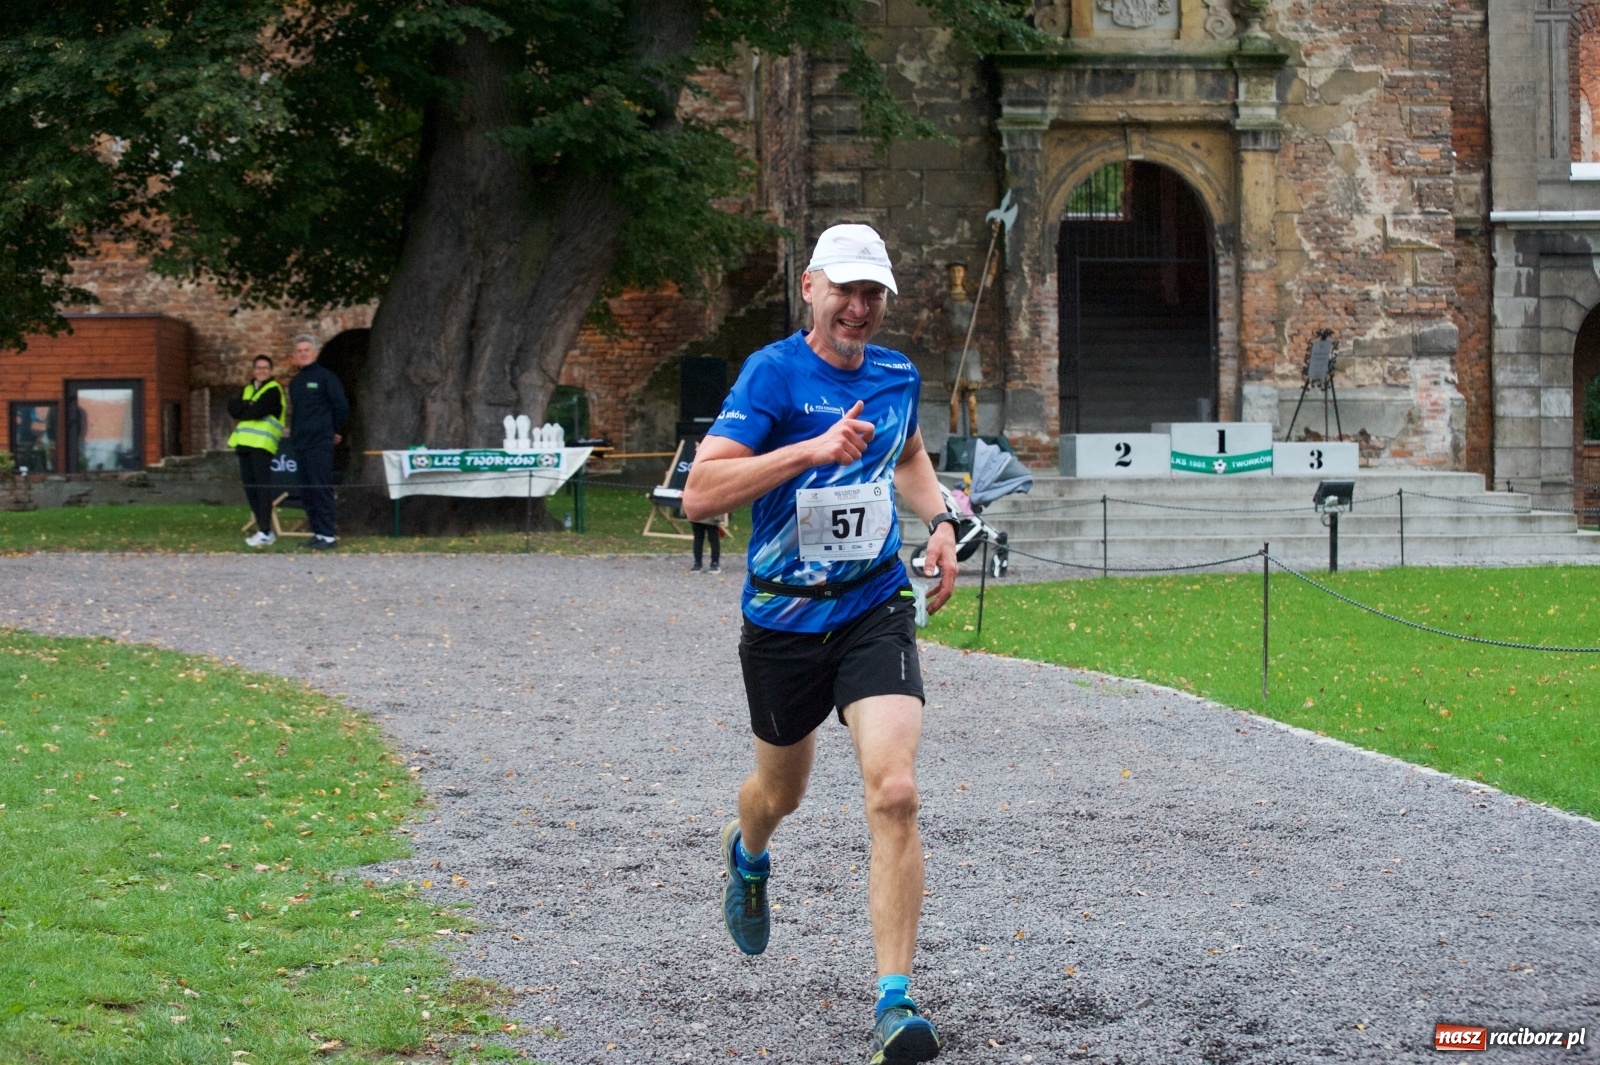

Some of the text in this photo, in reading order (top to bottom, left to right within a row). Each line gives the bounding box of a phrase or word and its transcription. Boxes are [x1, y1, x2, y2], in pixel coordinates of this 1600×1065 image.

[1216, 430, 1227, 453] 1
[434, 454, 535, 466] LKS TWORKÓW
[1115, 442, 1132, 467] 2
[1171, 456, 1187, 466] LKS
[1309, 449, 1323, 469] 3
[832, 507, 865, 539] 57
